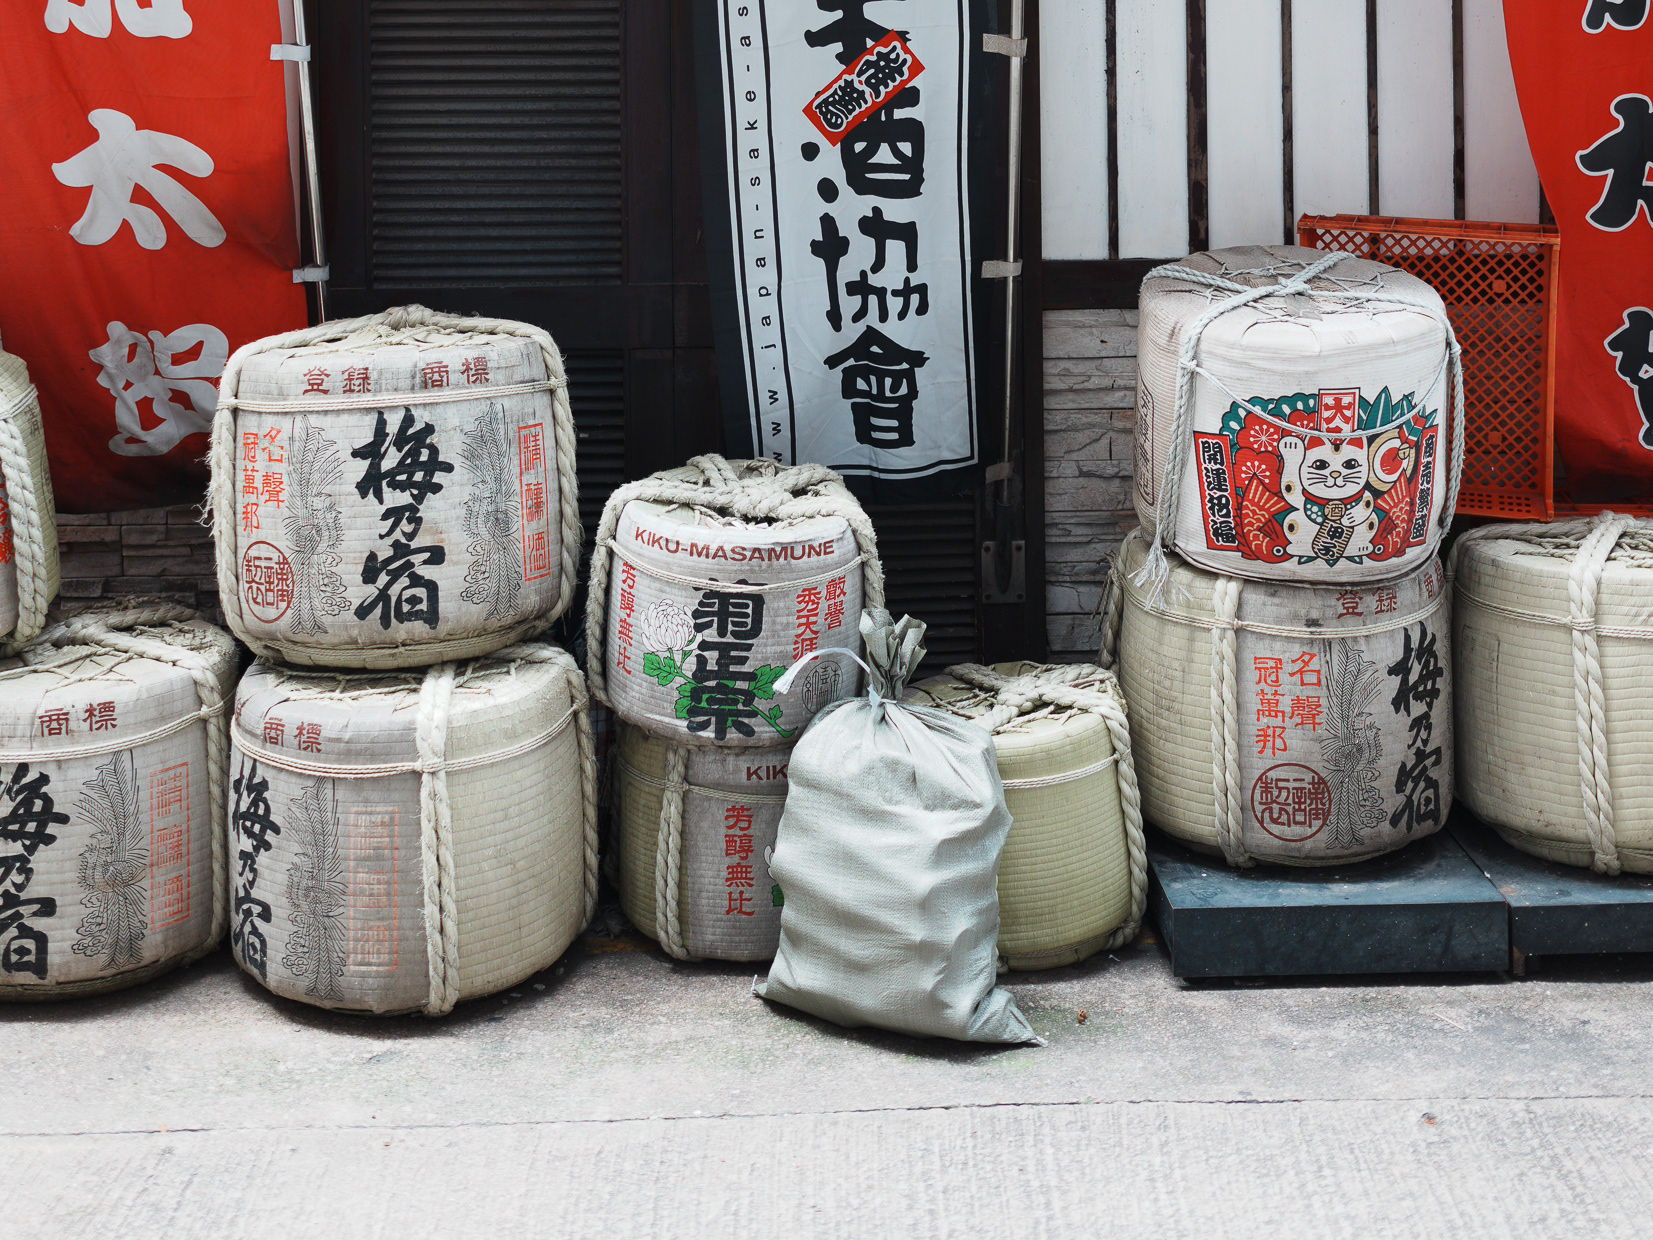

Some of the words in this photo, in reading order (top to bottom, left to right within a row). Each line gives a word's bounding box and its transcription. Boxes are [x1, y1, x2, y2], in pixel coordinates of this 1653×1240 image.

[351, 406, 455, 631] 梅乃宿
[635, 526, 835, 562] KIKU-MASAMUNE
[1200, 439, 1237, 545] 開運招福
[687, 577, 765, 740] 菊正宗
[38, 701, 118, 737] 商標
[264, 717, 322, 753] 商標
[1387, 620, 1445, 834] 梅乃宿
[232, 758, 281, 983] 梅乃宿
[724, 805, 755, 916] 芳醇無比
